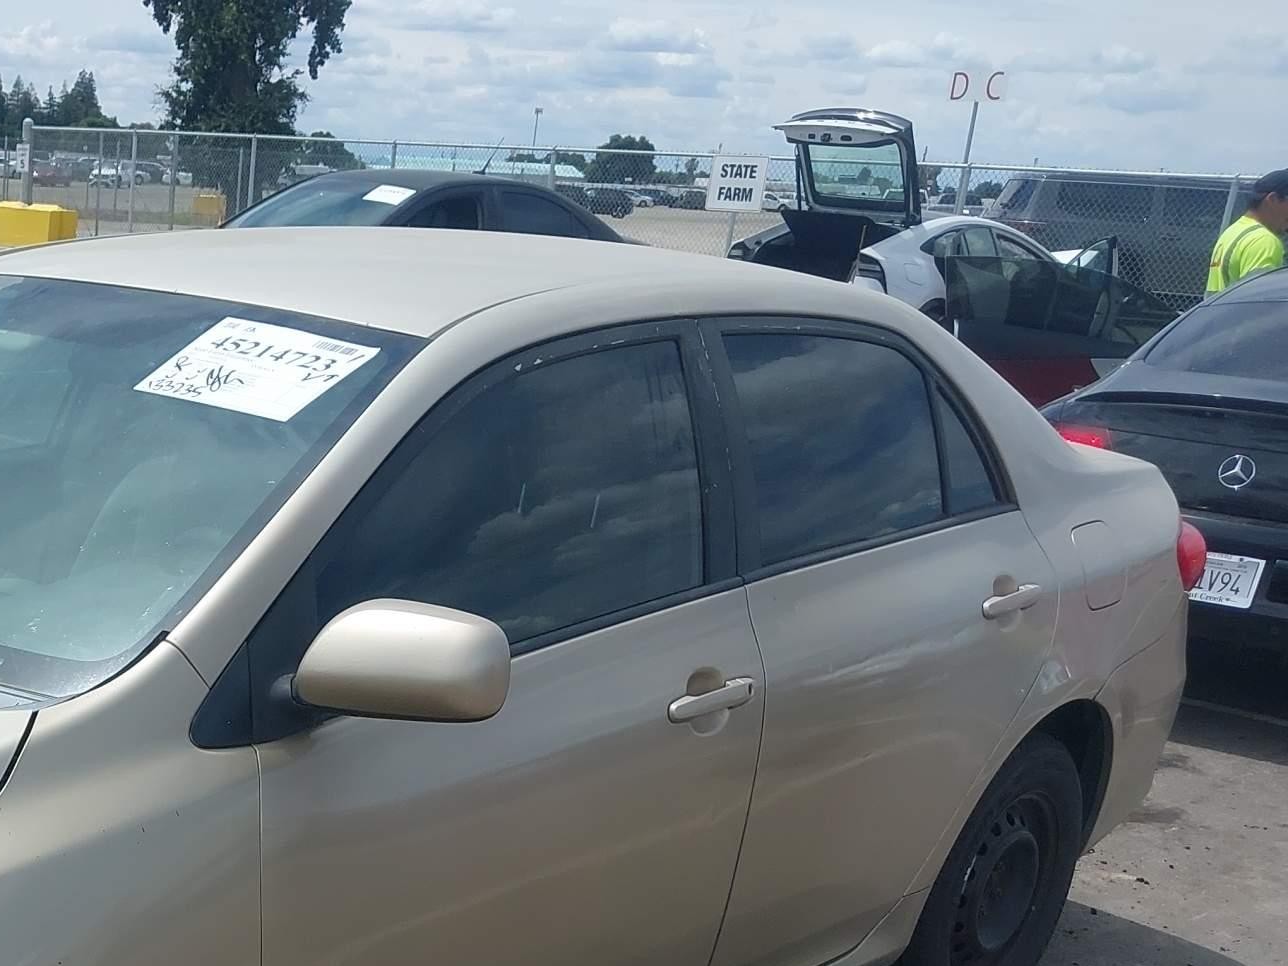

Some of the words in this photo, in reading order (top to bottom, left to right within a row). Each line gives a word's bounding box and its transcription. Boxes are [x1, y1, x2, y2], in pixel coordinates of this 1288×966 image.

[949, 71, 970, 101] D
[986, 71, 1005, 101] C
[720, 163, 758, 179] STATE
[717, 186, 754, 203] FARM
[211, 336, 337, 371] 45214723
